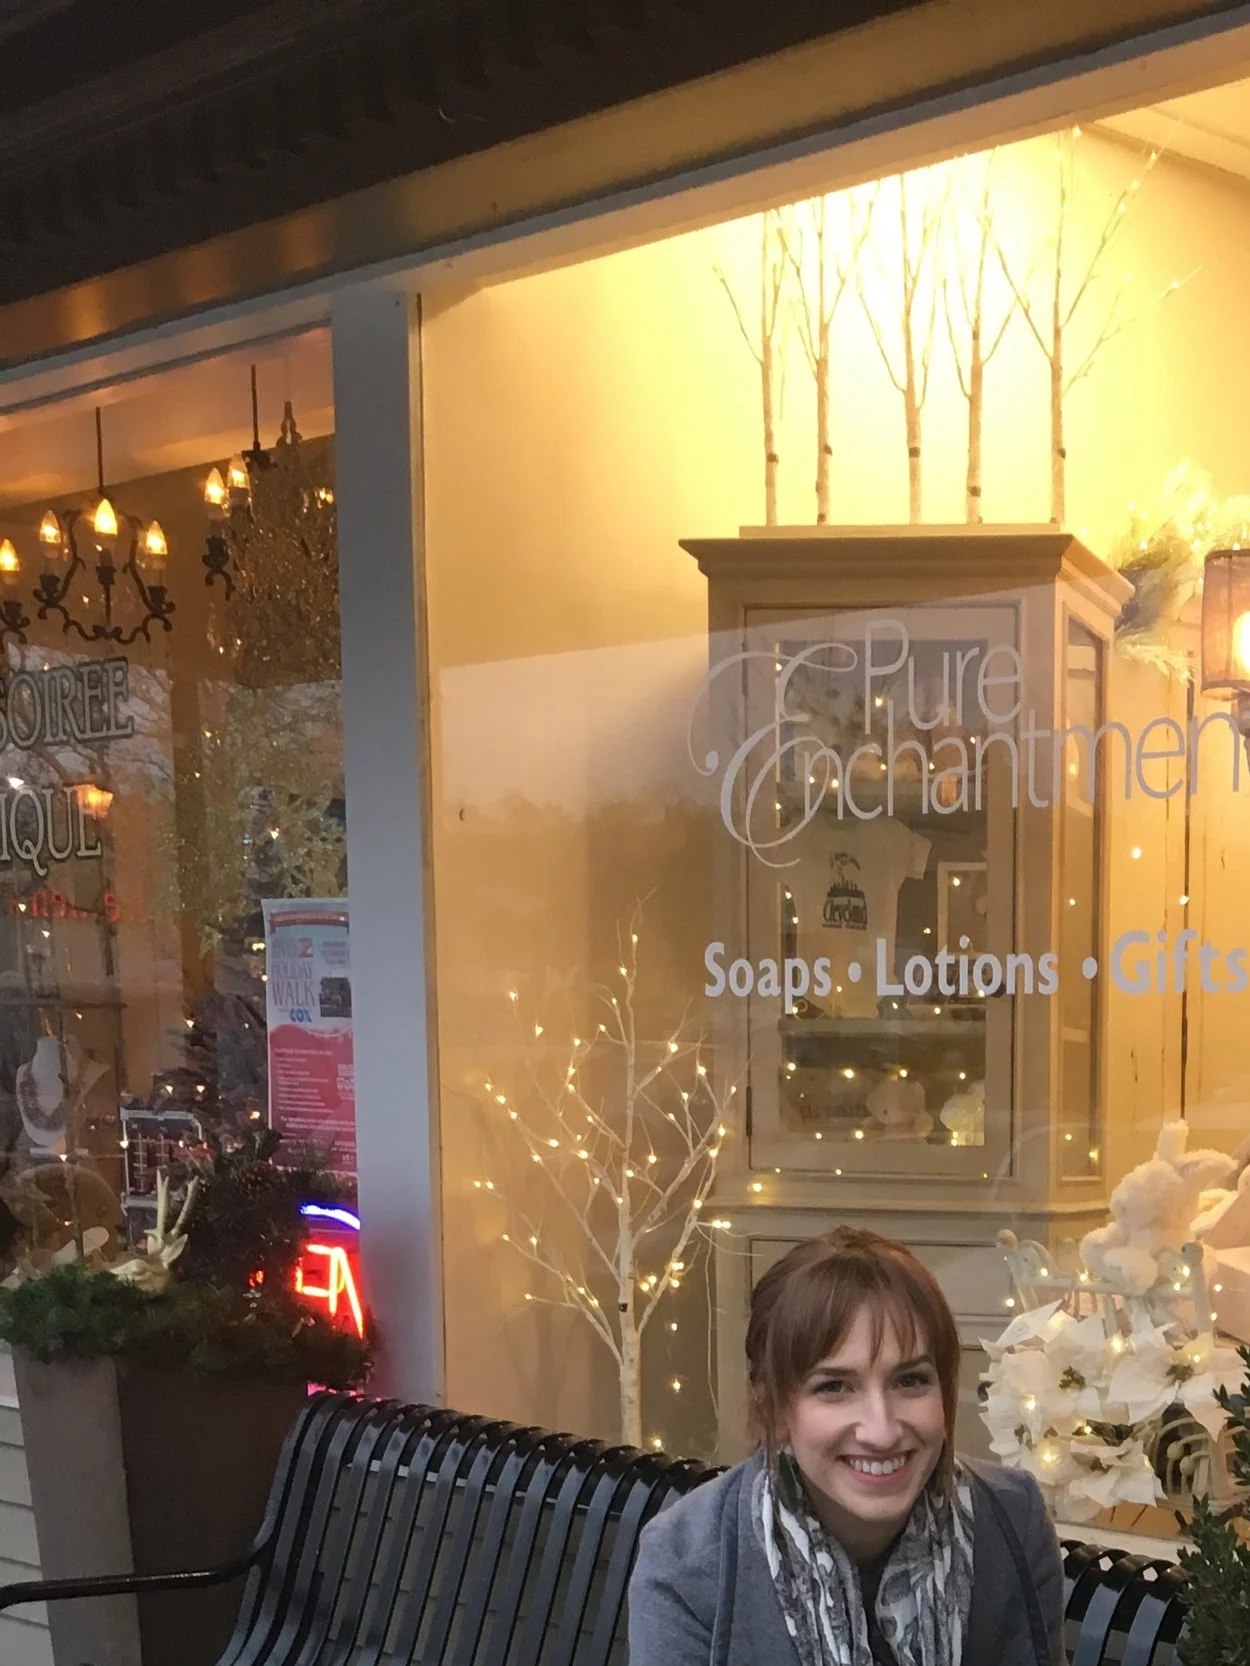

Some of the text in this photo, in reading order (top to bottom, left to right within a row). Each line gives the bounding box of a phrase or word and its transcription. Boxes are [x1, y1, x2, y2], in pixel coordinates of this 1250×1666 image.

[863, 618, 1023, 735] Pure
[271, 980, 316, 1007] WALK
[702, 929, 1250, 1015] Soaps Lotions Gifts
